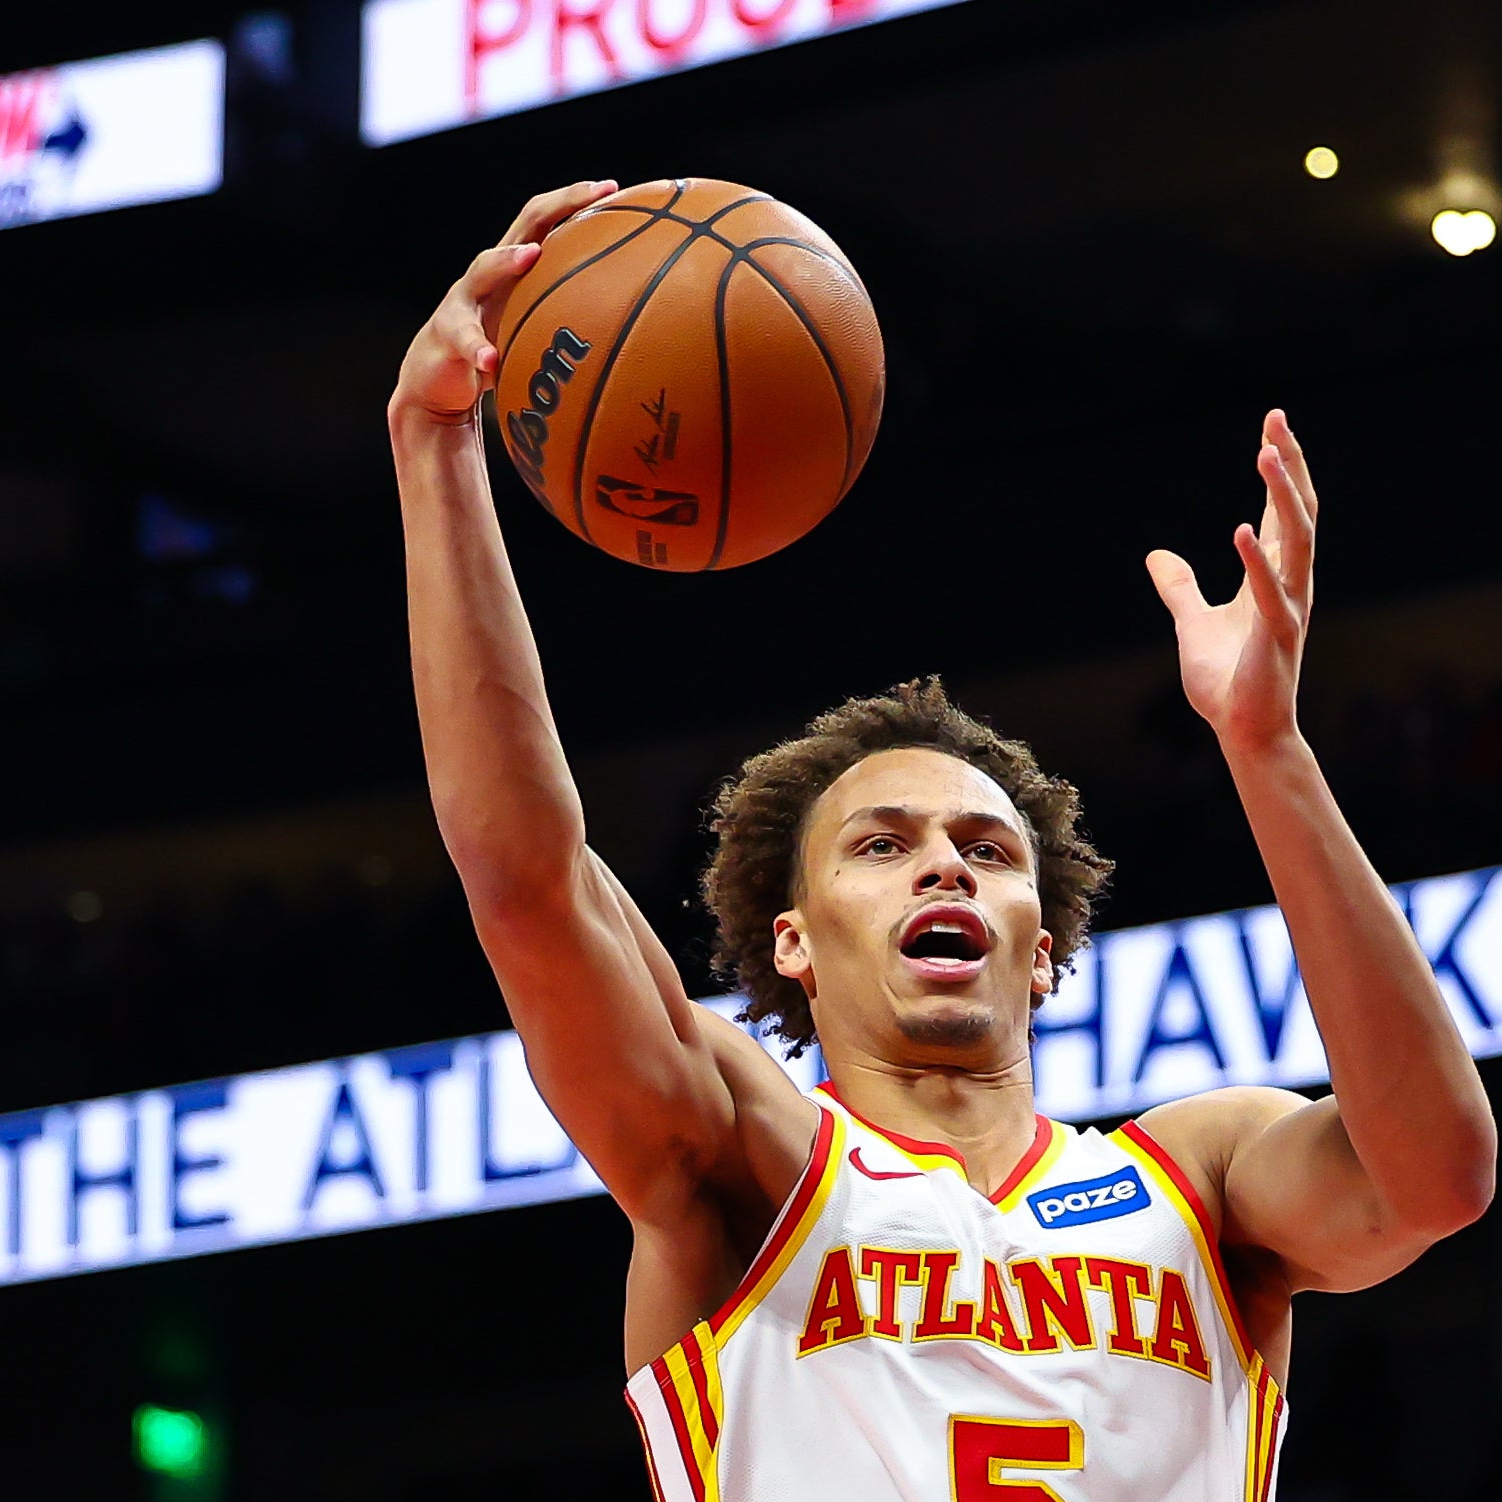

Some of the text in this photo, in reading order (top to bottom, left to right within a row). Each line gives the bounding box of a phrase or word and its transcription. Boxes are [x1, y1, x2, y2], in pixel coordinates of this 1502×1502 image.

[507, 326, 593, 500] ilson
[1037, 1178, 1138, 1226] paze
[796, 1245, 1211, 1382] ATLANTA
